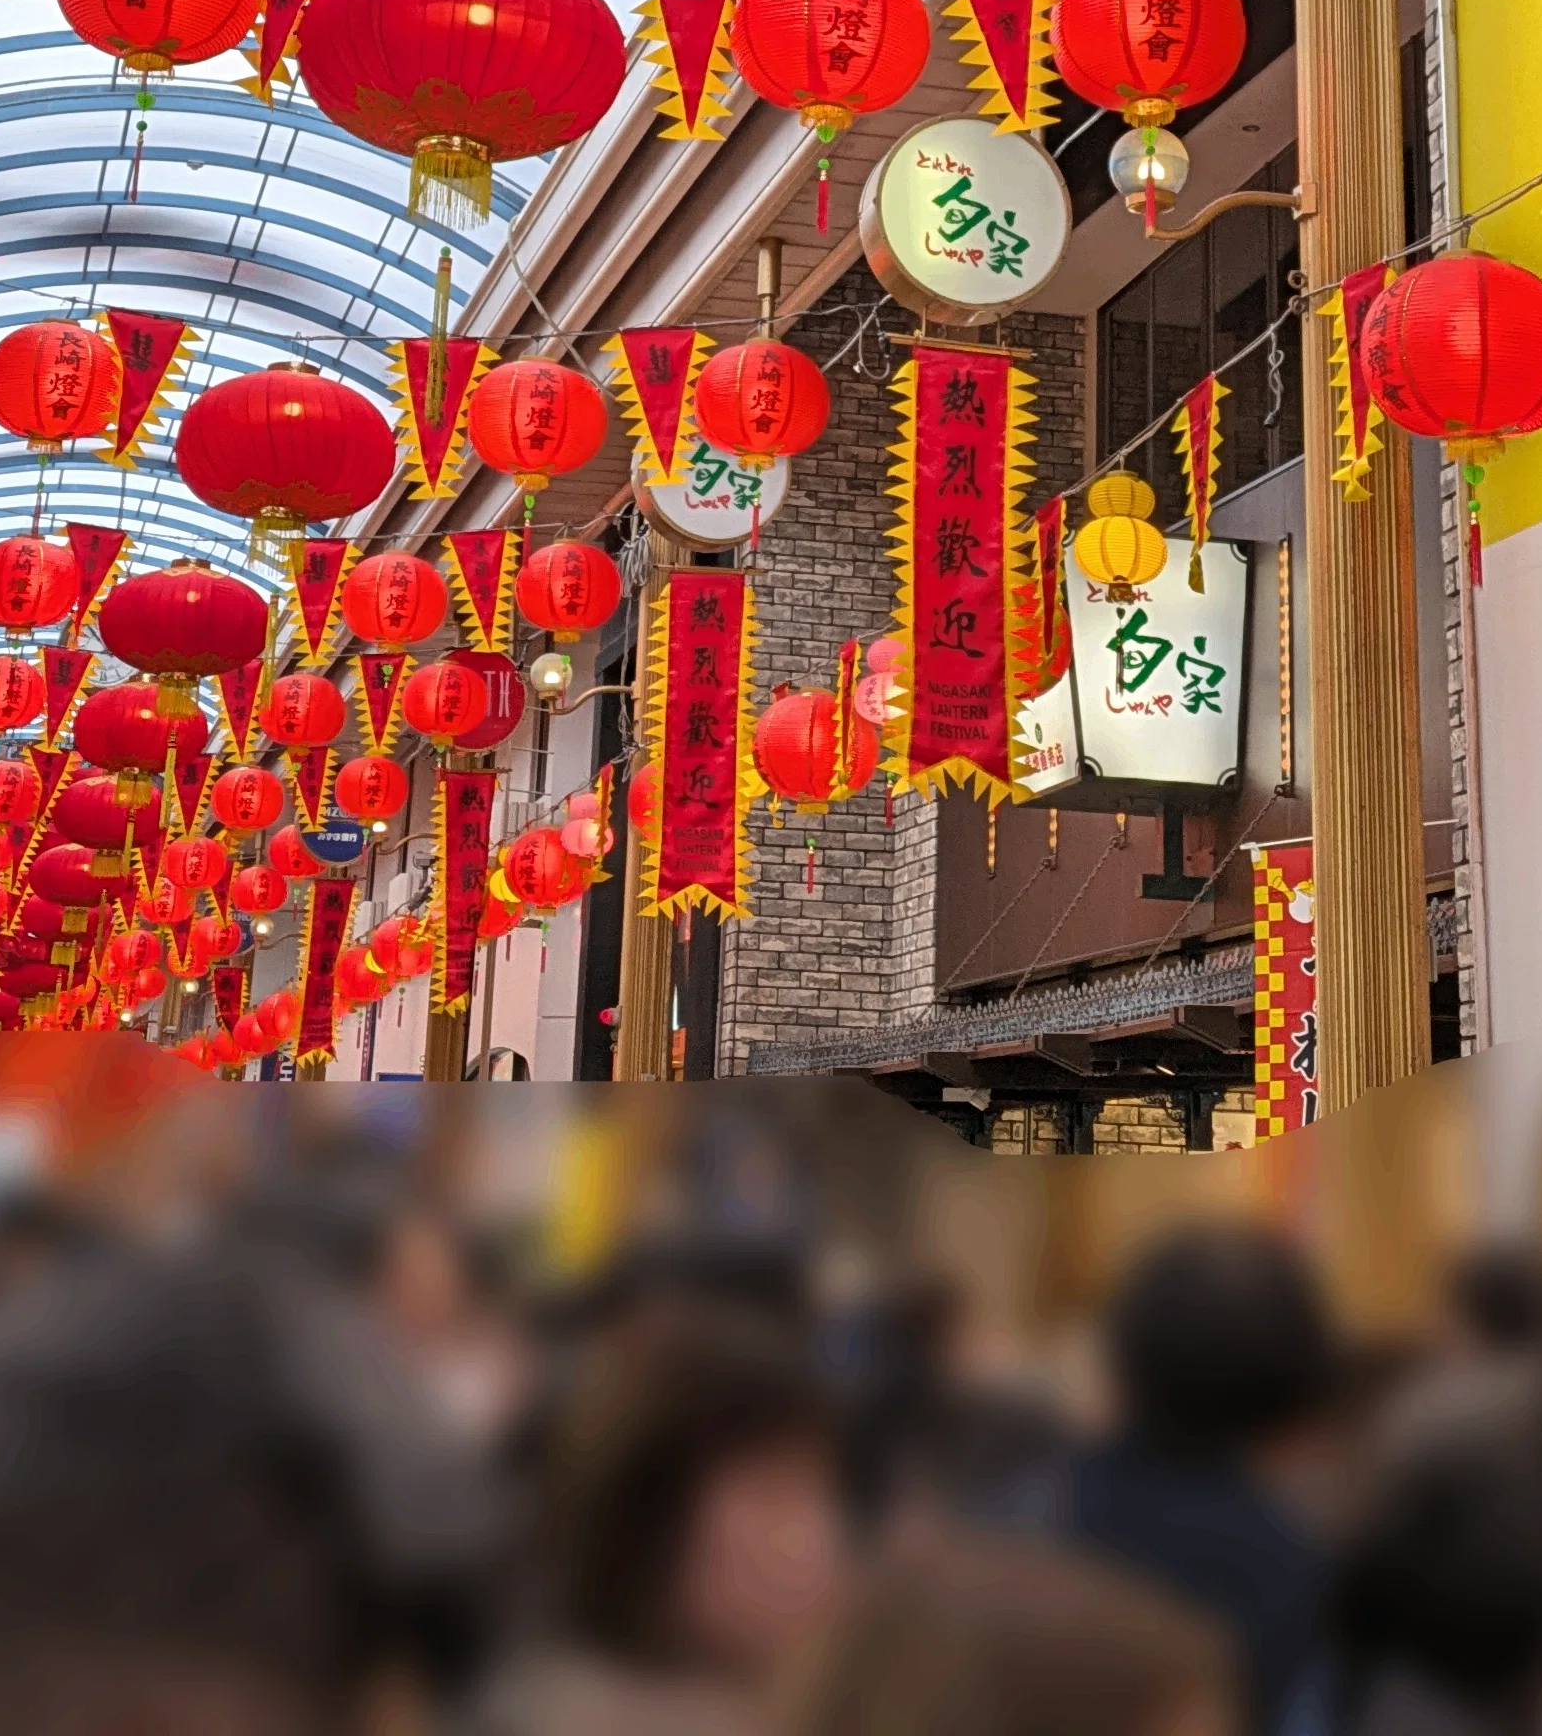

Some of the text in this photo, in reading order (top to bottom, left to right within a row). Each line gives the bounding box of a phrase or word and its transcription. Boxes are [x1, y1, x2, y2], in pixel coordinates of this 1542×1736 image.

[929, 367, 989, 659] 熱烈歡迎
[927, 680, 992, 699] NAGASAKI
[930, 703, 989, 721] LANTERN
[930, 721, 990, 741] FESTIVAL
